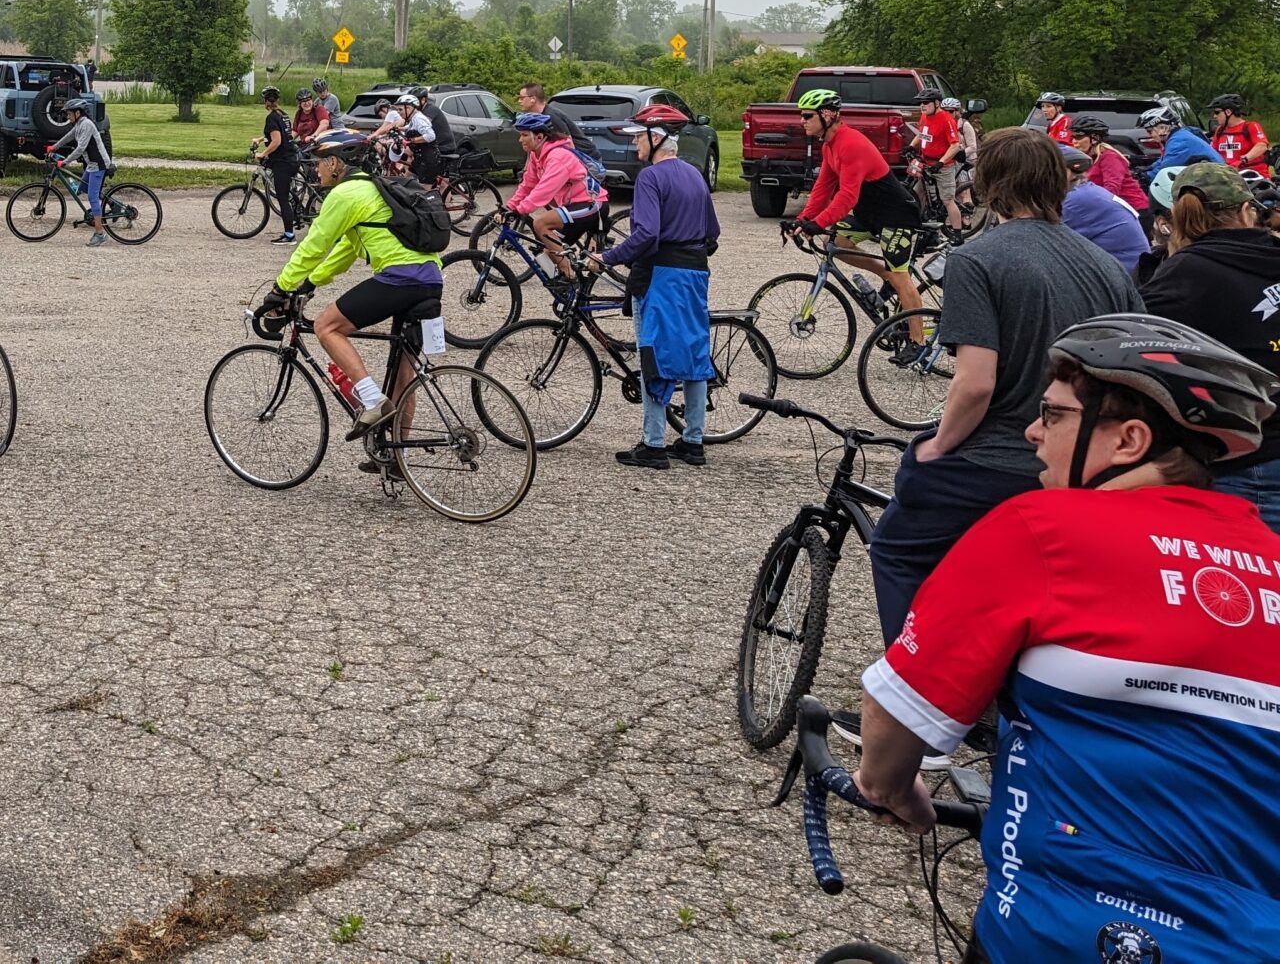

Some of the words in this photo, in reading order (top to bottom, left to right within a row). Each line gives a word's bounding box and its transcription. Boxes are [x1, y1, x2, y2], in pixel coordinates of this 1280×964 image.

[1119, 340, 1201, 351] BONTRAGER
[1149, 534, 1201, 559] WE
[1202, 543, 1261, 576] WILL
[1124, 677, 1178, 693] SUICIDE
[1181, 684, 1256, 708] PREVENTION
[996, 785, 1028, 919] Products
